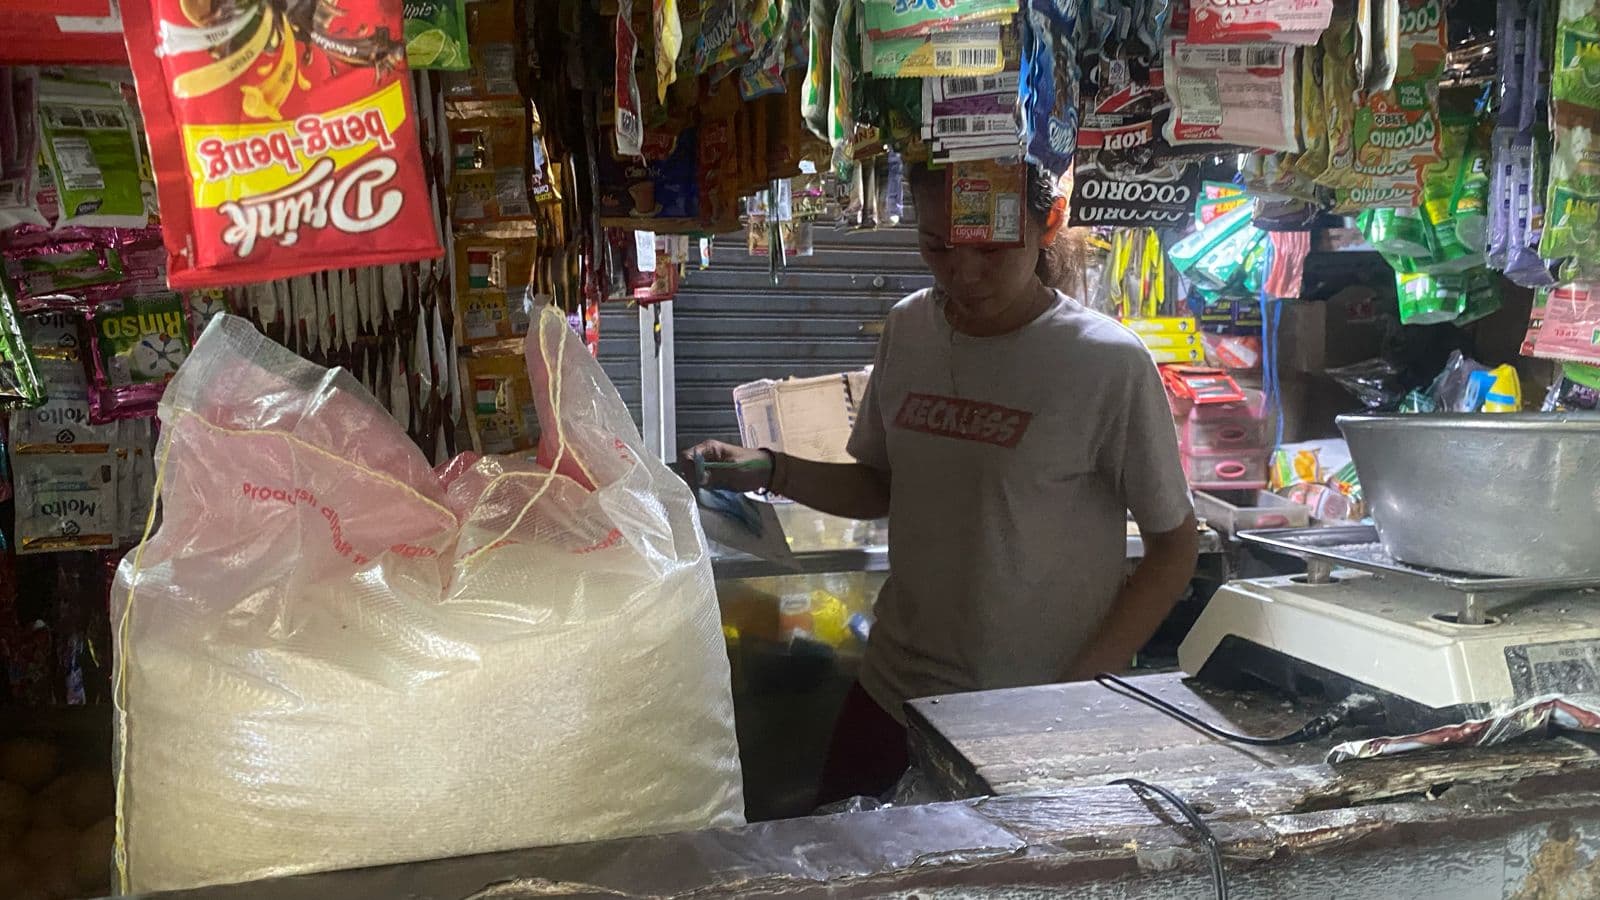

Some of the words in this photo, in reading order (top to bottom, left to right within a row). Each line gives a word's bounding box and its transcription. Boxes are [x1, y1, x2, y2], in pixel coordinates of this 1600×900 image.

[311, 31, 357, 55] chocolate
[200, 108, 395, 178] beng-beng
[1104, 129, 1148, 149] KOPI
[1371, 112, 1435, 148] COCORIO
[1081, 180, 1191, 204] COCORIO
[222, 158, 402, 256] Drink
[102, 311, 183, 338] Rinso
[904, 398, 1020, 441] RECKLESS
[41, 500, 96, 518] Molto
